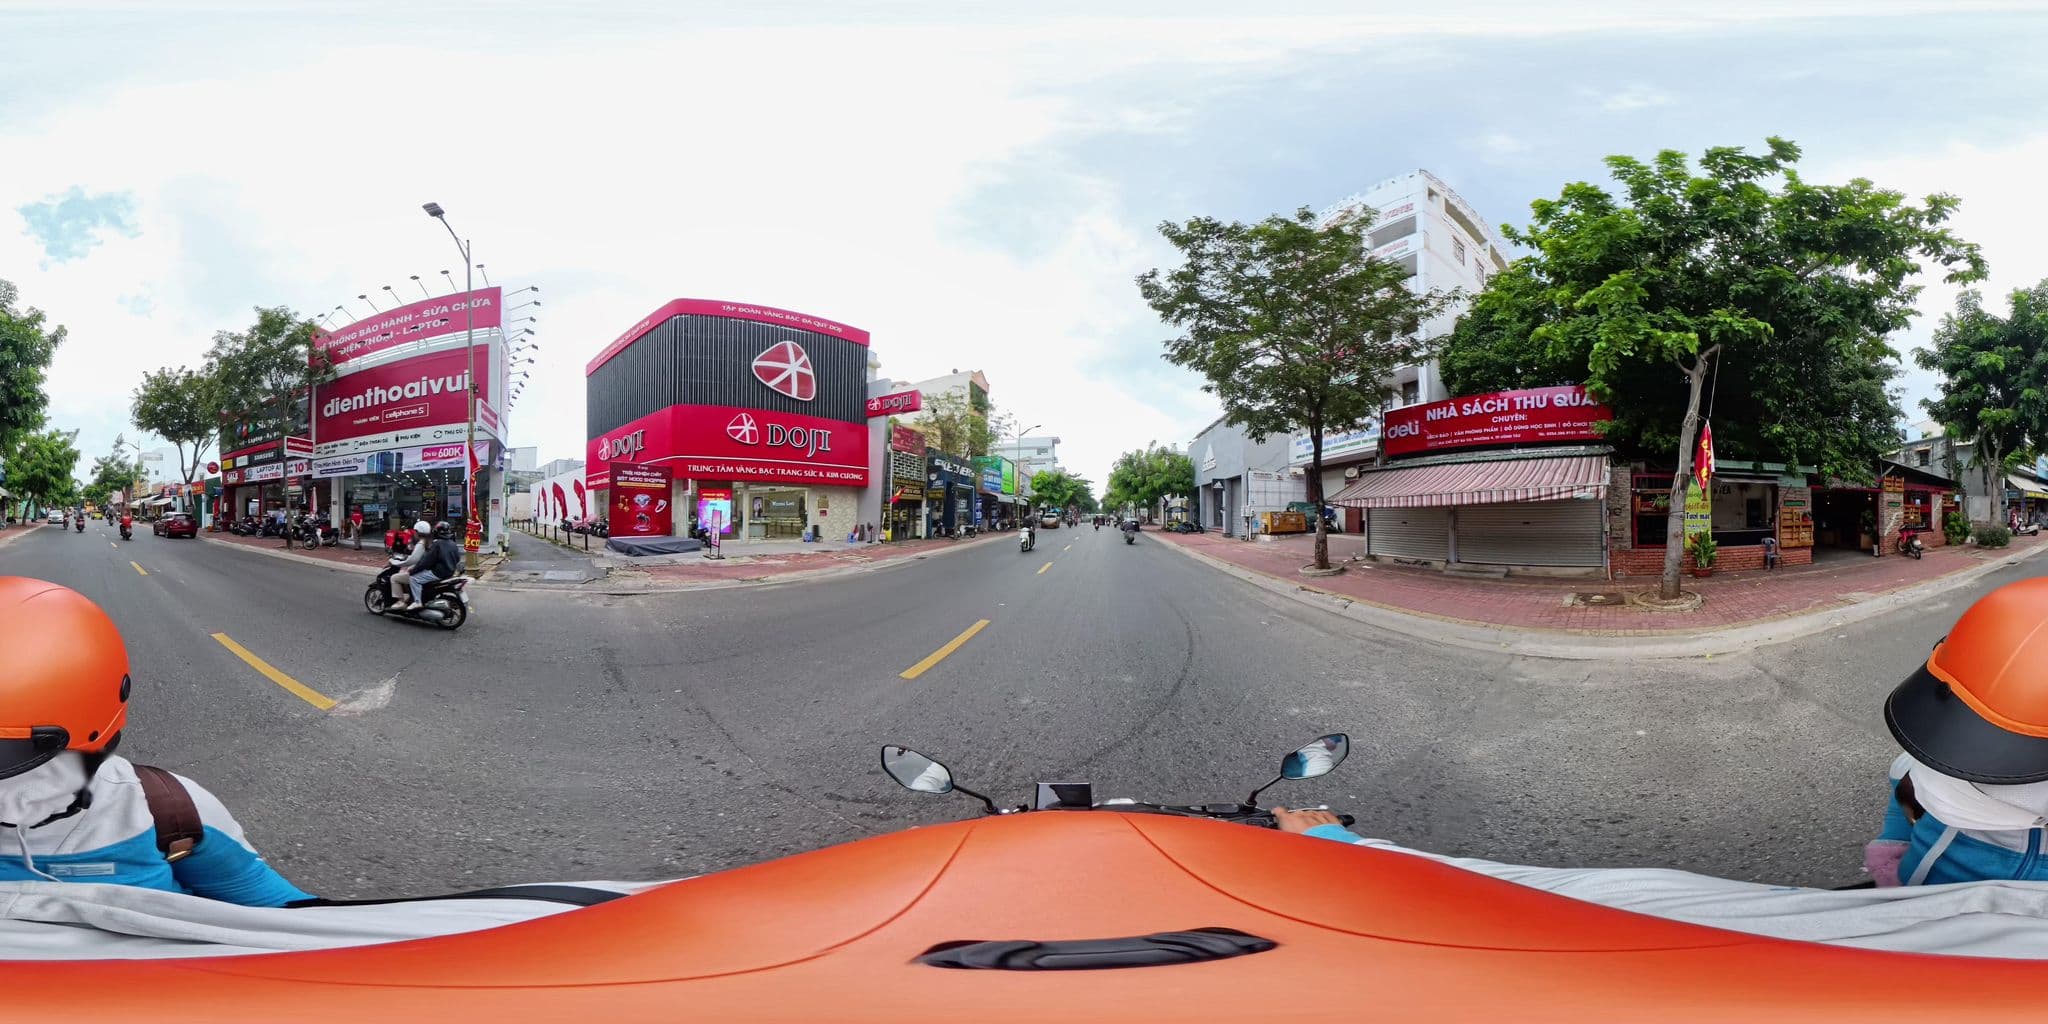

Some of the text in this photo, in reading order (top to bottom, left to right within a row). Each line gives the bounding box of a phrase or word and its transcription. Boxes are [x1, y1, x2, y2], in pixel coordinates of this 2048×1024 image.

[763, 309, 783, 319] VÀNG
[329, 331, 357, 348] THỐNG
[359, 323, 378, 337] BẢO
[381, 313, 412, 329] HÀNH
[423, 304, 449, 318] SỬA
[323, 369, 470, 418] dienthoaivui
[883, 394, 912, 410] DOJI
[1426, 402, 1458, 421] NHÀ
[1462, 398, 1509, 417] SÁCH
[1513, 393, 1549, 410] THƯ
[766, 423, 831, 458] DOJI
[1387, 421, 1419, 439] deli
[438, 446, 462, 458] 600K
[611, 429, 646, 461] DOJI
[687, 464, 715, 473] TRUNG
[716, 464, 734, 473] TÂM
[736, 463, 757, 474] VÀNG
[758, 466, 774, 476] BẠC
[777, 468, 802, 477] TRANG
[804, 468, 817, 477] SỨC
[826, 471, 839, 479] KIM
[840, 471, 863, 481] CƯƠNG
